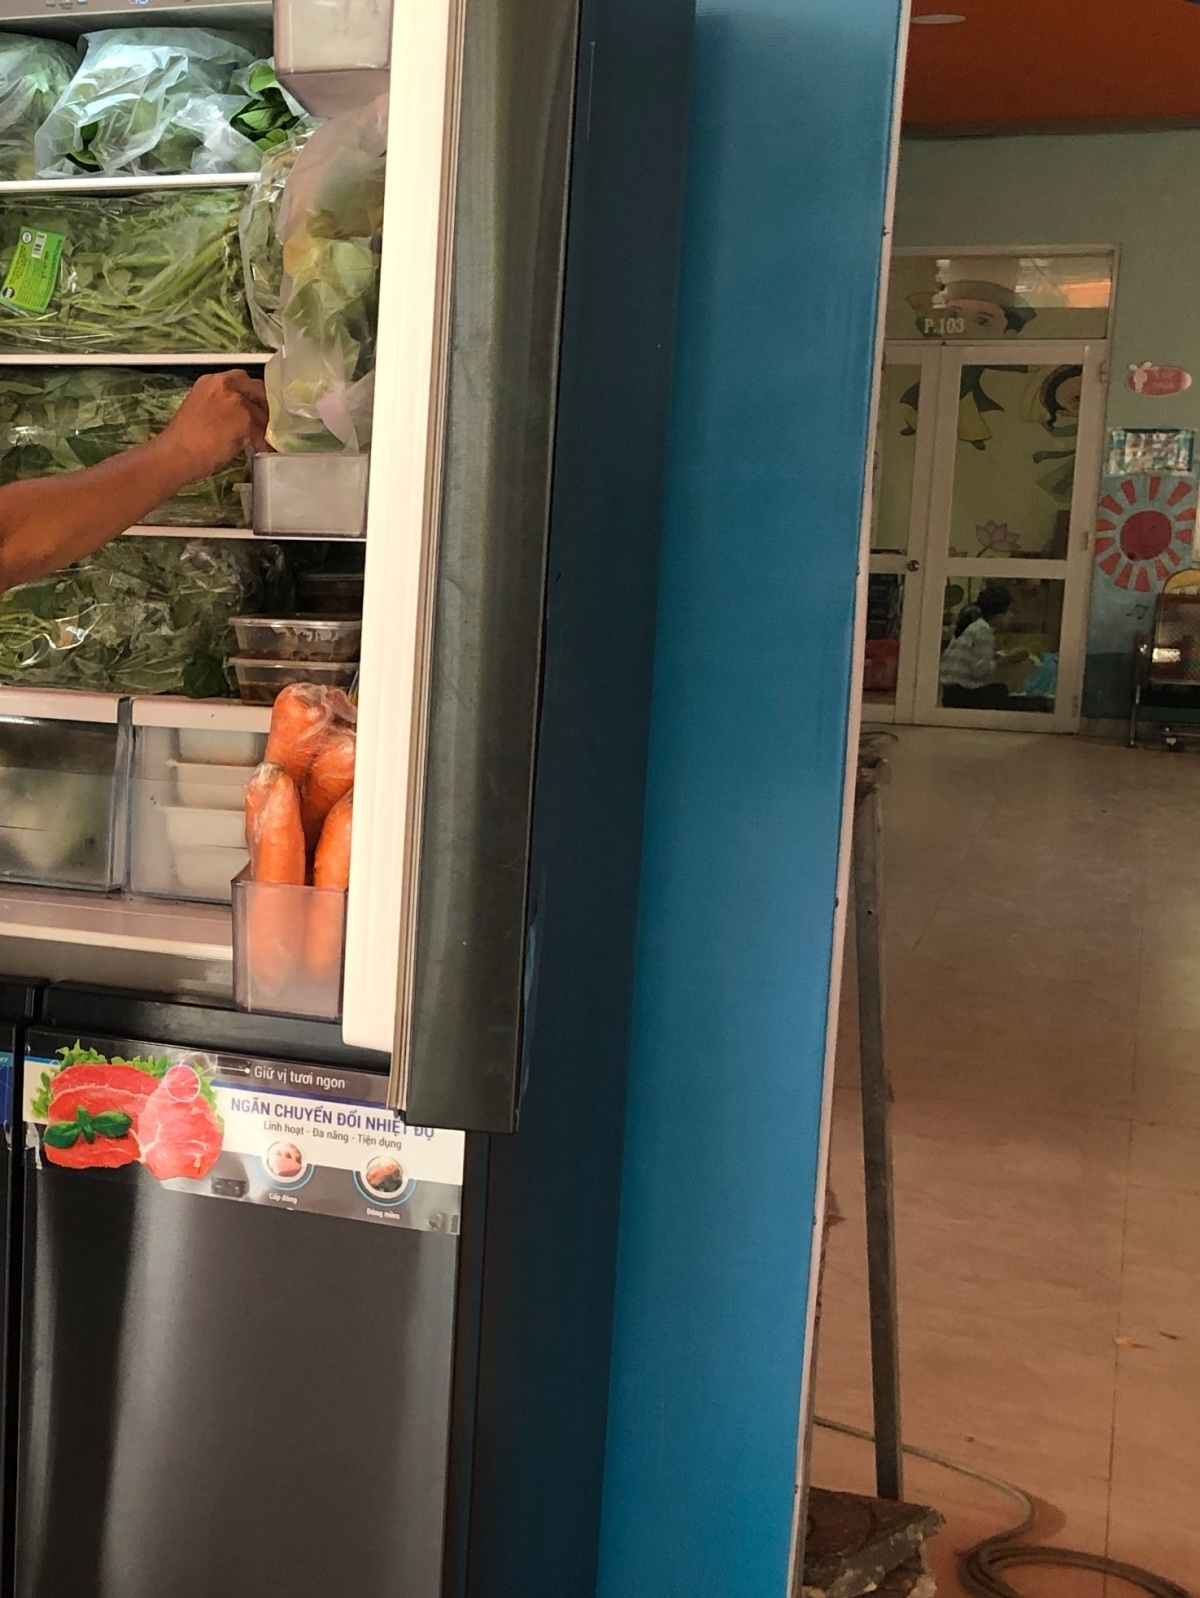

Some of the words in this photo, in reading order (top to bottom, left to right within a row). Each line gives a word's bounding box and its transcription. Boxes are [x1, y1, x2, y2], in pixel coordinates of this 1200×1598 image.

[923, 317, 965, 334] P.103
[254, 1065, 275, 1080] Giữ
[276, 1068, 288, 1084] vị
[289, 1070, 314, 1085] tươi
[316, 1076, 346, 1090] ngon
[231, 1097, 271, 1115] NGĂN
[274, 1105, 333, 1124] CHUYỂN
[336, 1109, 361, 1128] ĐỔI
[263, 1121, 282, 1132] Linh
[284, 1123, 305, 1136] hoạt
[312, 1127, 325, 1138] Đa
[326, 1131, 349, 1143] năng
[357, 1134, 377, 1146] Tiện
[378, 1137, 402, 1150] dụng
